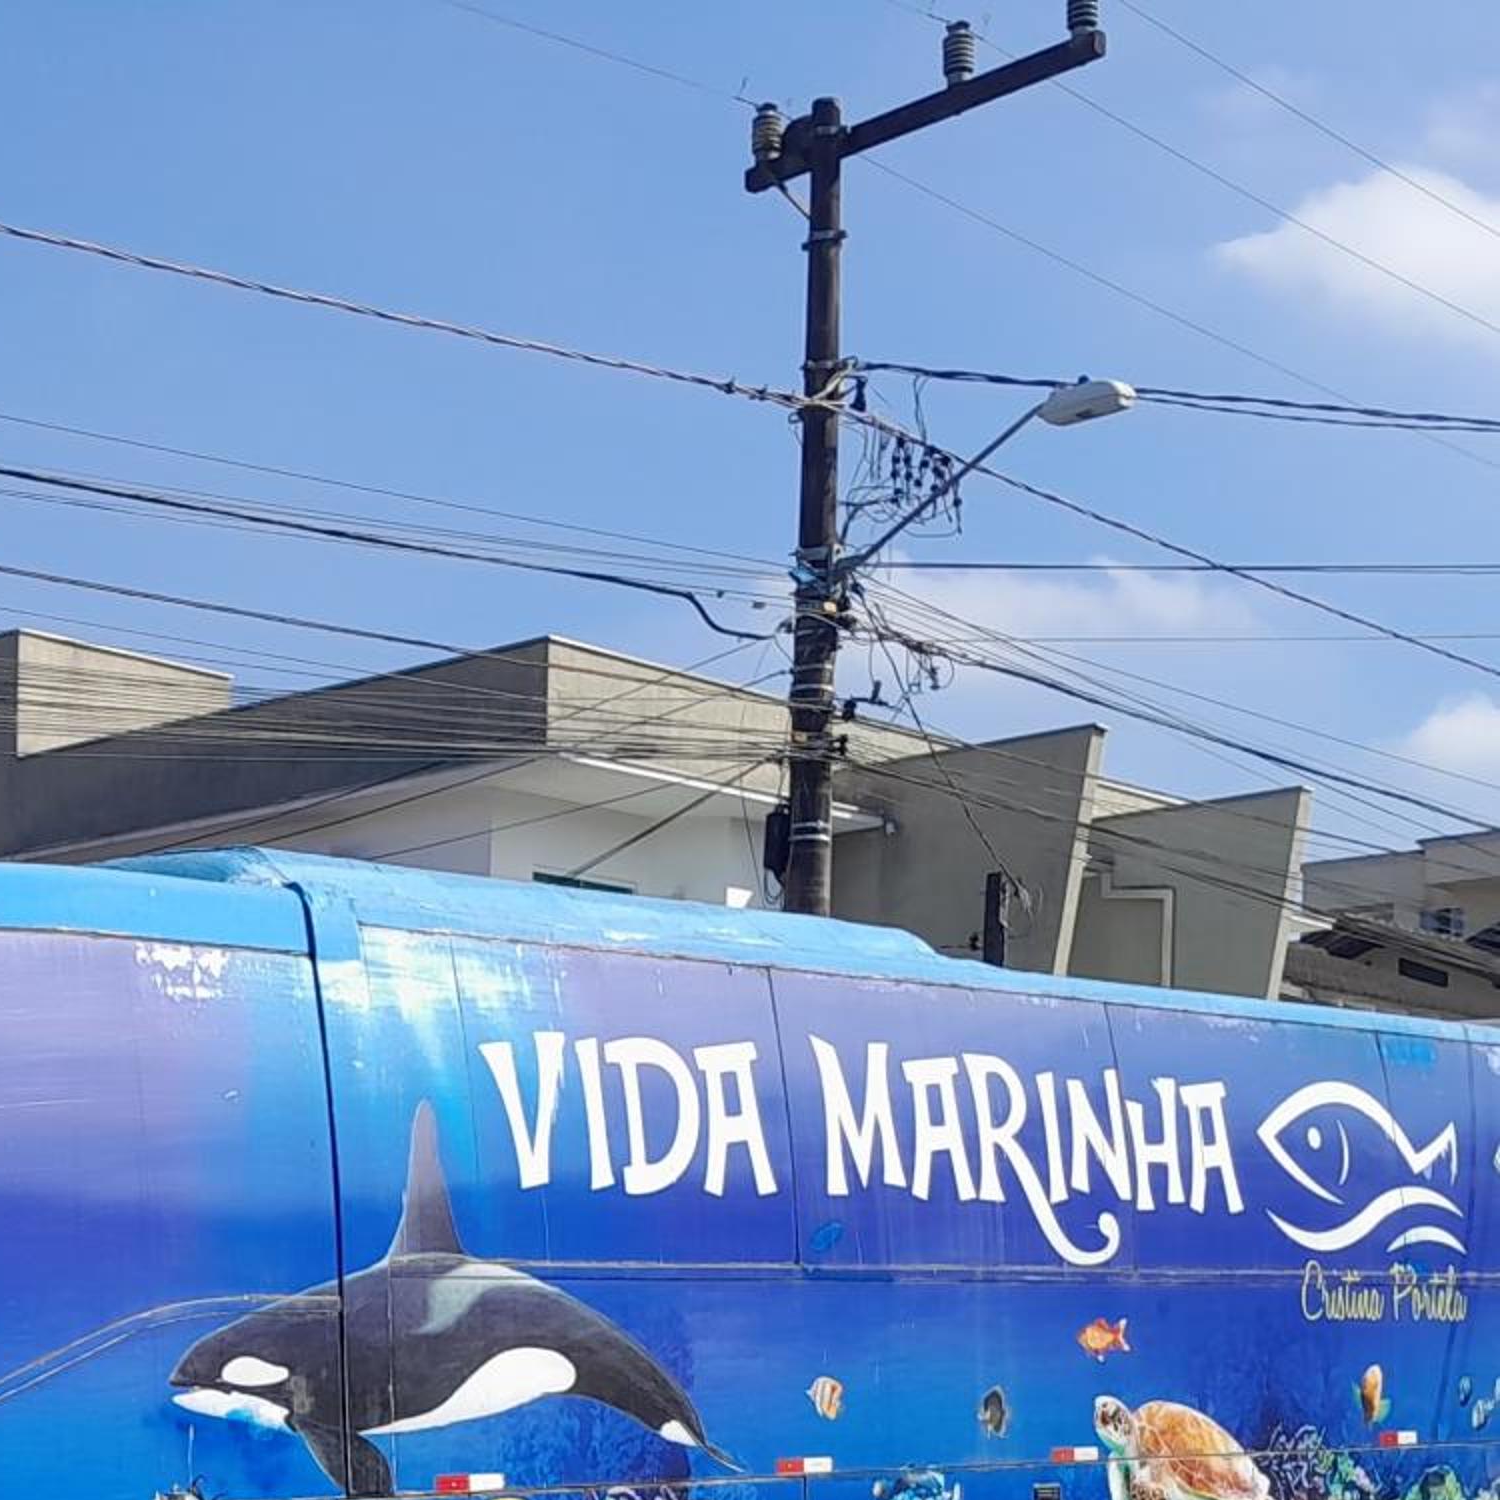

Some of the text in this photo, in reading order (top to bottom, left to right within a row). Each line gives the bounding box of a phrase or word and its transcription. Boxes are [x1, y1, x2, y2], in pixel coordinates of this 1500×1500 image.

[479, 1031, 1244, 1265] VIDA MARINHA
[1302, 1260, 1384, 1320] Cristina
